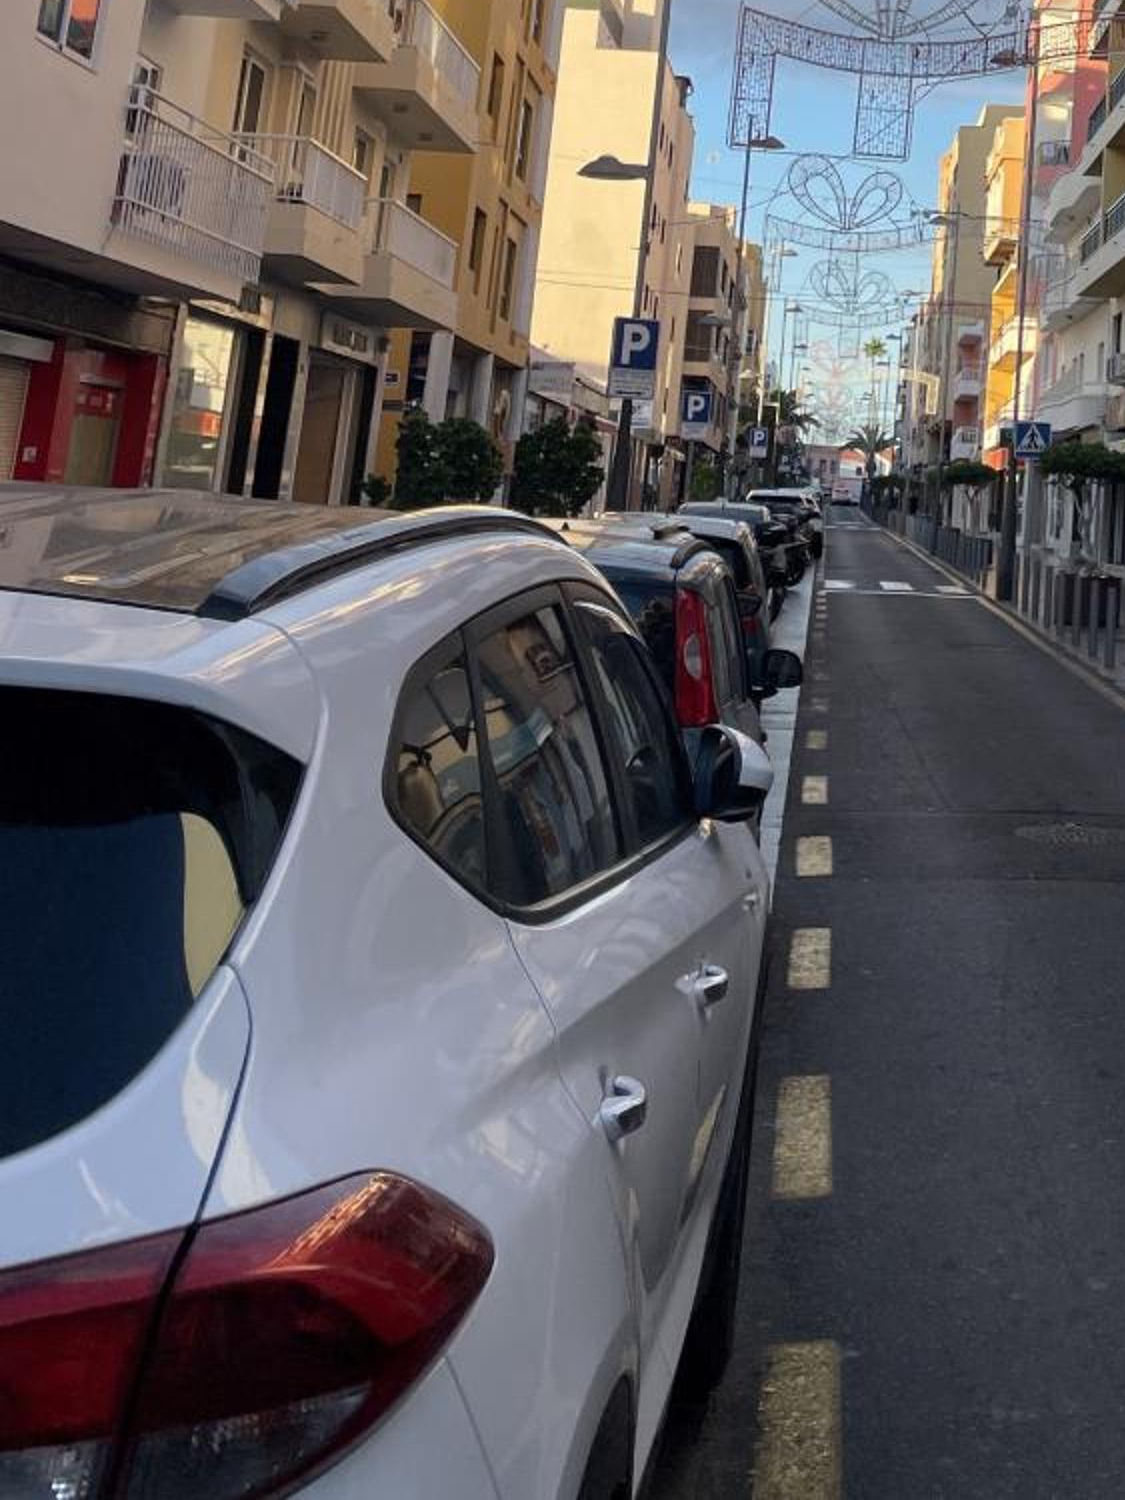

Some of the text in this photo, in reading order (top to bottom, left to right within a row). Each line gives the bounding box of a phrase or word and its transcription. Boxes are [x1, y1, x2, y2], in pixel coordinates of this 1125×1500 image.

[619, 323, 651, 365] P
[687, 395, 705, 421] P
[753, 431, 765, 445] P
